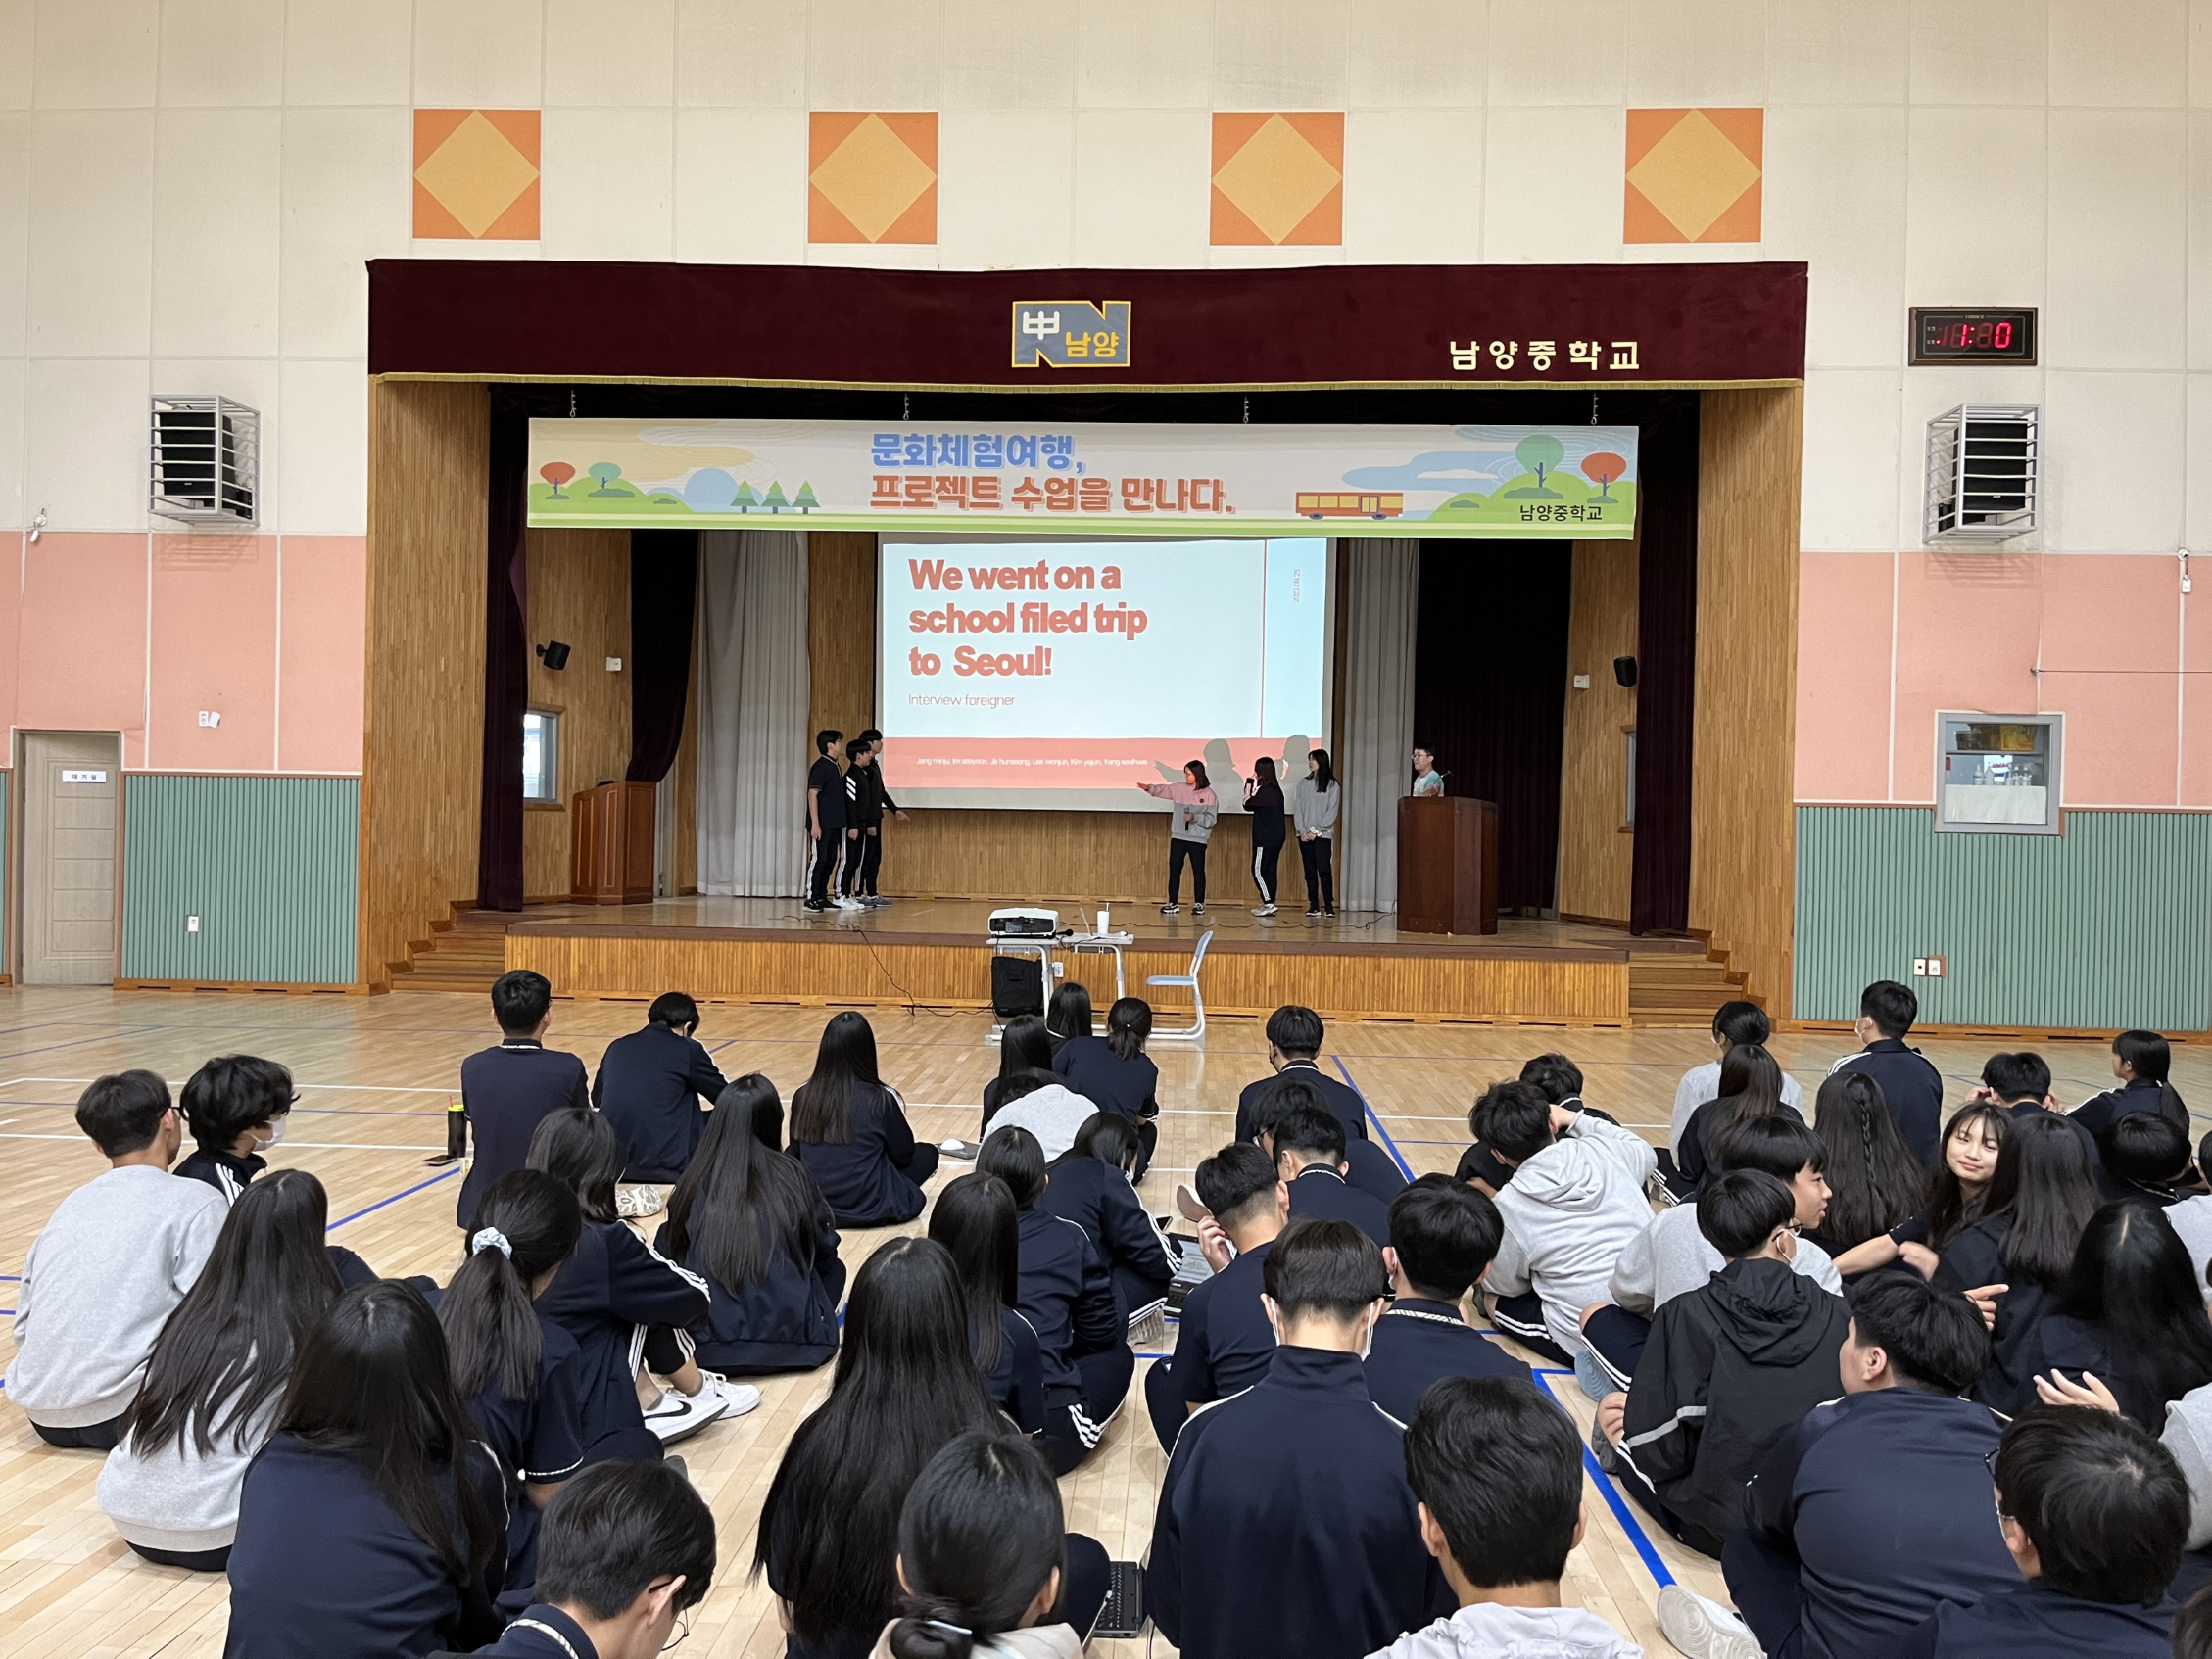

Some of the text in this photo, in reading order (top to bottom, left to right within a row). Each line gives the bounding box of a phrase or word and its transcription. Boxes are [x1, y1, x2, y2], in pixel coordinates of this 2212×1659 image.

[1065, 331, 1120, 358] 남양
[1449, 340, 1640, 371] 남양중학교
[870, 432, 1086, 475] 문화체험여행,
[870, 475, 1236, 515] 프로젝트 수업을 만나다.
[1519, 504, 1603, 522] 남양중학교
[908, 558, 1122, 590] We went on a
[908, 601, 1148, 641] school filed trip
[908, 644, 1053, 677] to Seoul!
[908, 693, 1017, 710] Interview foreigner
